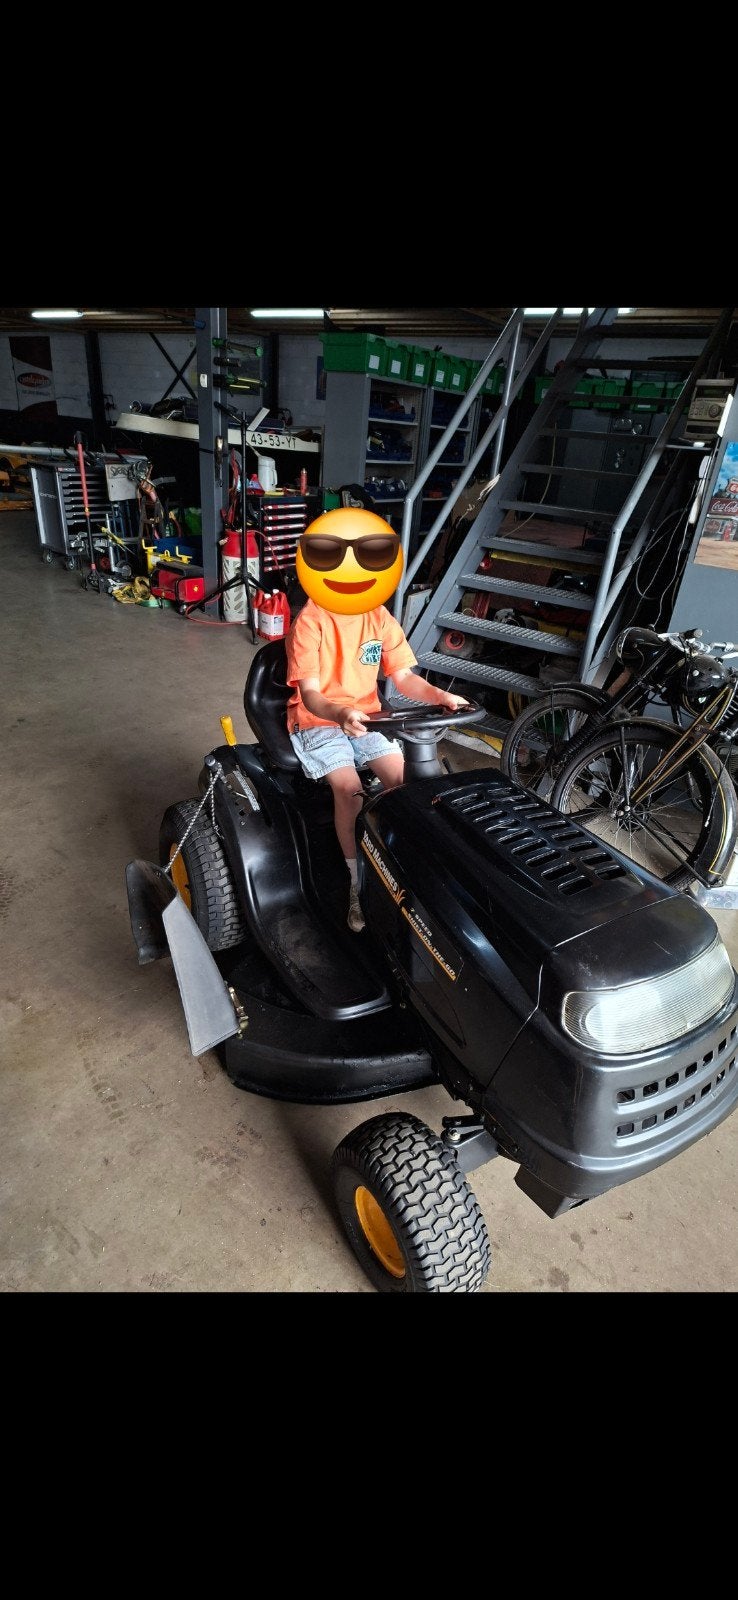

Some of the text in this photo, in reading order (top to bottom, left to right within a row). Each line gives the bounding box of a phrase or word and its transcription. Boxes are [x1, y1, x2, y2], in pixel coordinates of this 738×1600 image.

[250, 433, 297, 449] 43-53-YT
[363, 830, 398, 892] YARD MACHINES
[414, 914, 433, 937] SPEED
